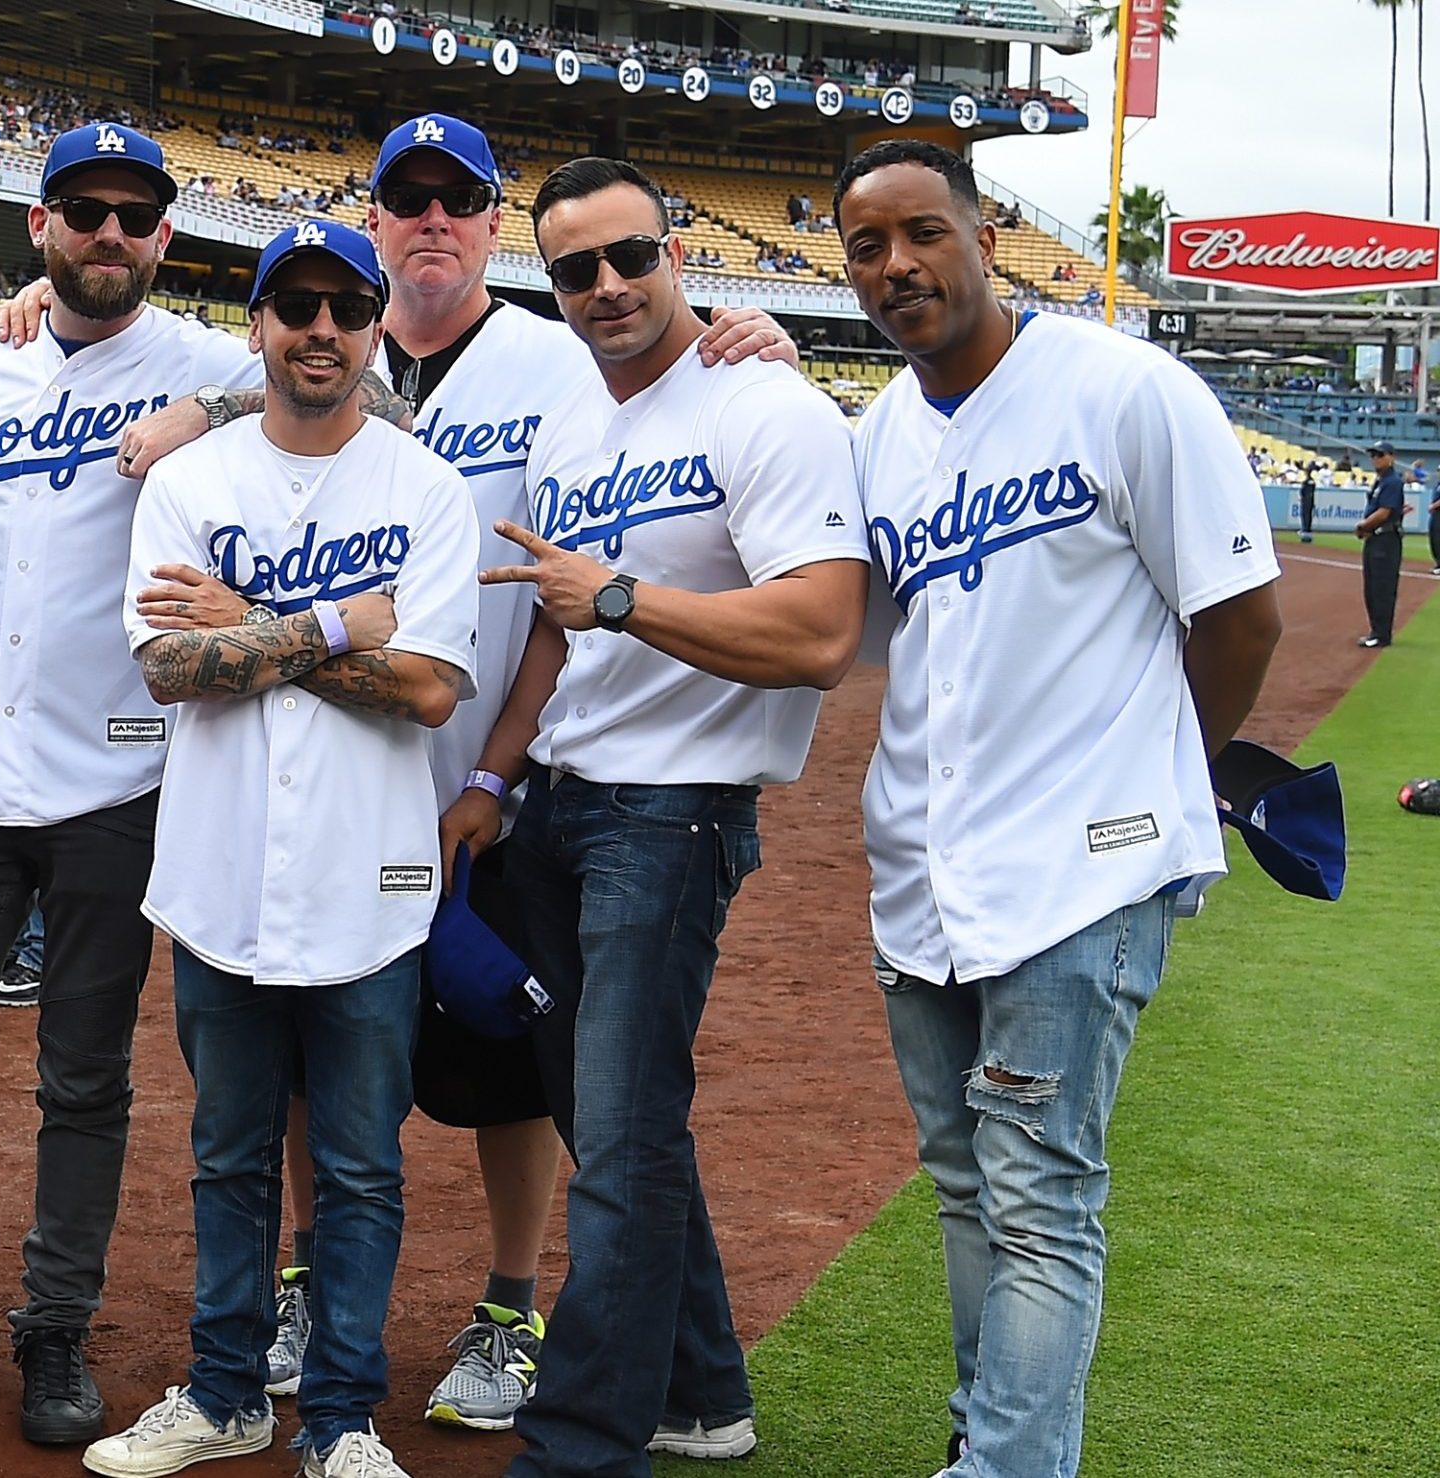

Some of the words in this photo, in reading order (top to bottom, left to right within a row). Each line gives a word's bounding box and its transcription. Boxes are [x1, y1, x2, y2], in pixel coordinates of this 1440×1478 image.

[381, 27, 388, 45] 1
[1130, 19, 1158, 59] Fly
[440, 38, 449, 56] 2
[500, 48, 509, 67] 4
[561, 58, 575, 76] 19
[622, 67, 641, 85] 20
[685, 75, 706, 93] 24
[752, 84, 772, 102] 32
[820, 90, 839, 108] 39
[886, 93, 908, 116] 42
[954, 102, 973, 120] 53
[95, 125, 126, 153] LA
[413, 117, 445, 143] LA
[292, 221, 326, 247] LA
[1178, 228, 1435, 270] Budweiser
[1158, 314, 1186, 334] 4:31
[412, 407, 543, 477] dgers
[533, 450, 726, 560] Dodgers
[1334, 505, 1364, 520] Amer
[870, 461, 1100, 616] Dodgers
[209, 521, 411, 614] Dodgers
[1106, 822, 1150, 837] Majestic
